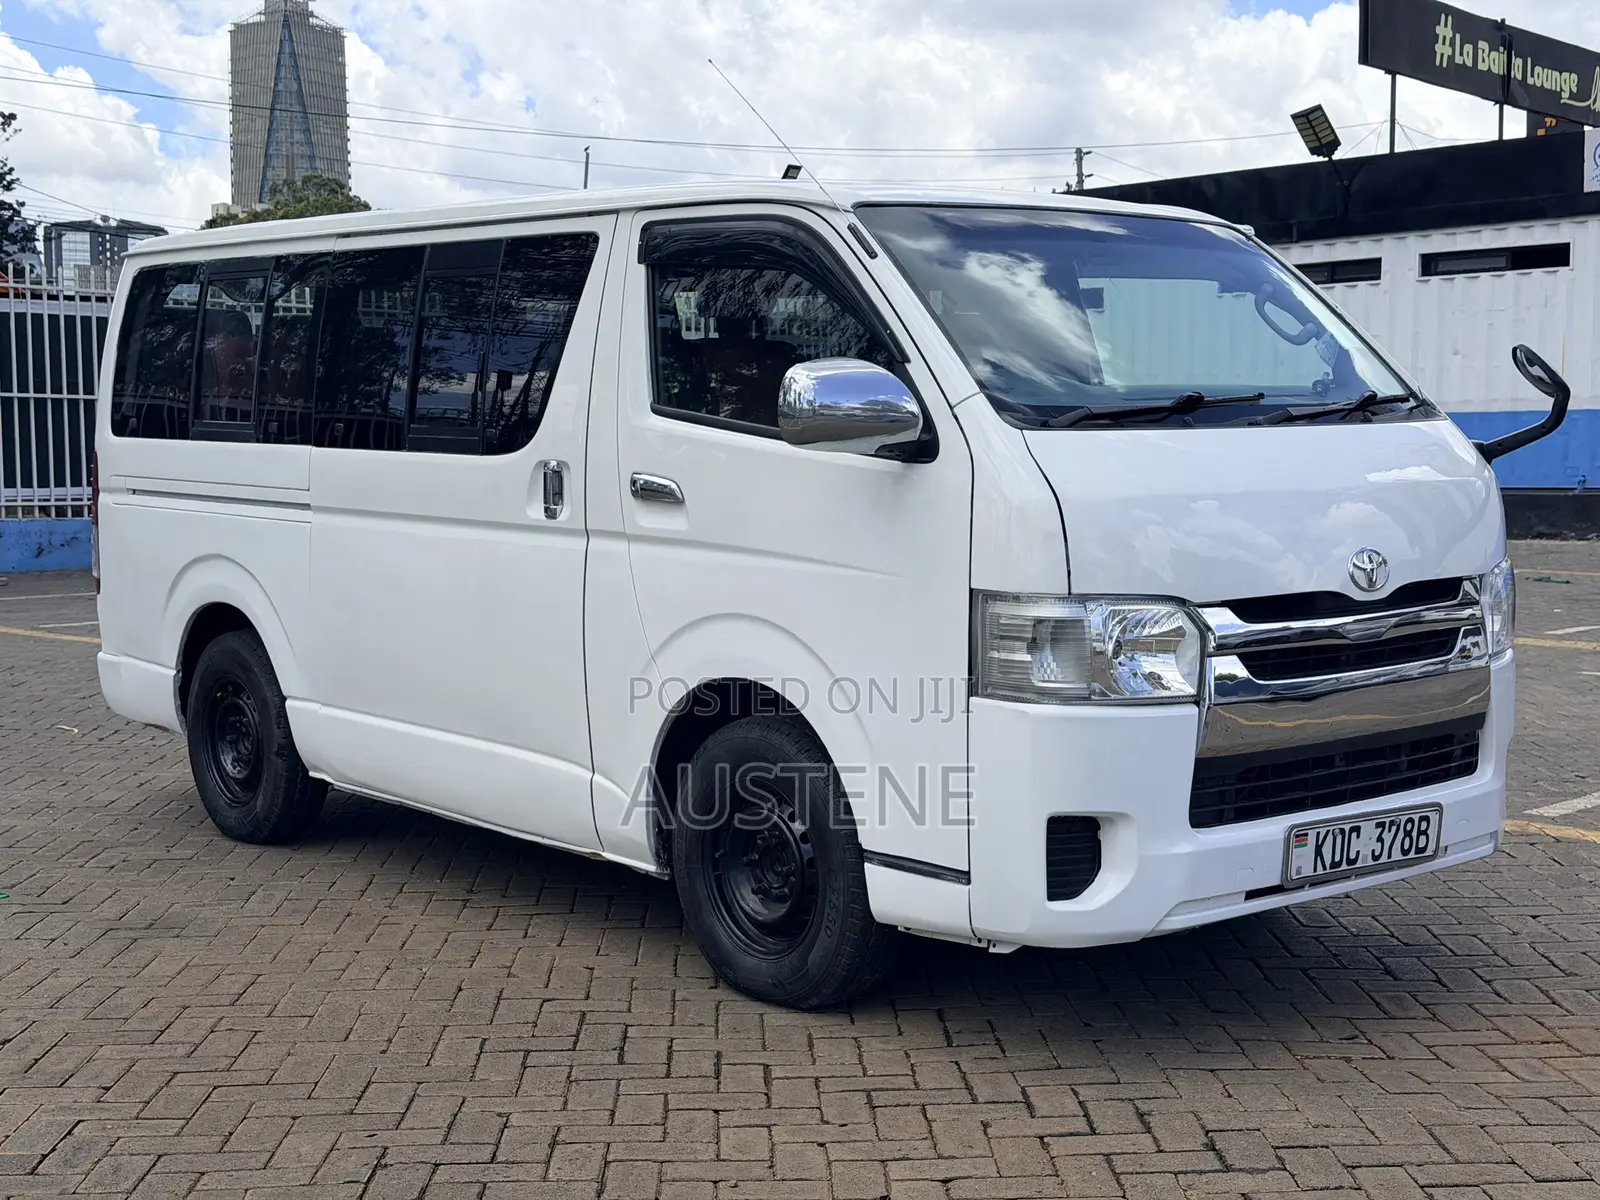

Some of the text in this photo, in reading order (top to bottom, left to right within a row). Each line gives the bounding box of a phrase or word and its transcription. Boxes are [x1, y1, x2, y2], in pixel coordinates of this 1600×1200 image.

[1527, 57, 1578, 98] Lounge
[1313, 815, 1430, 873] KDC 378B
